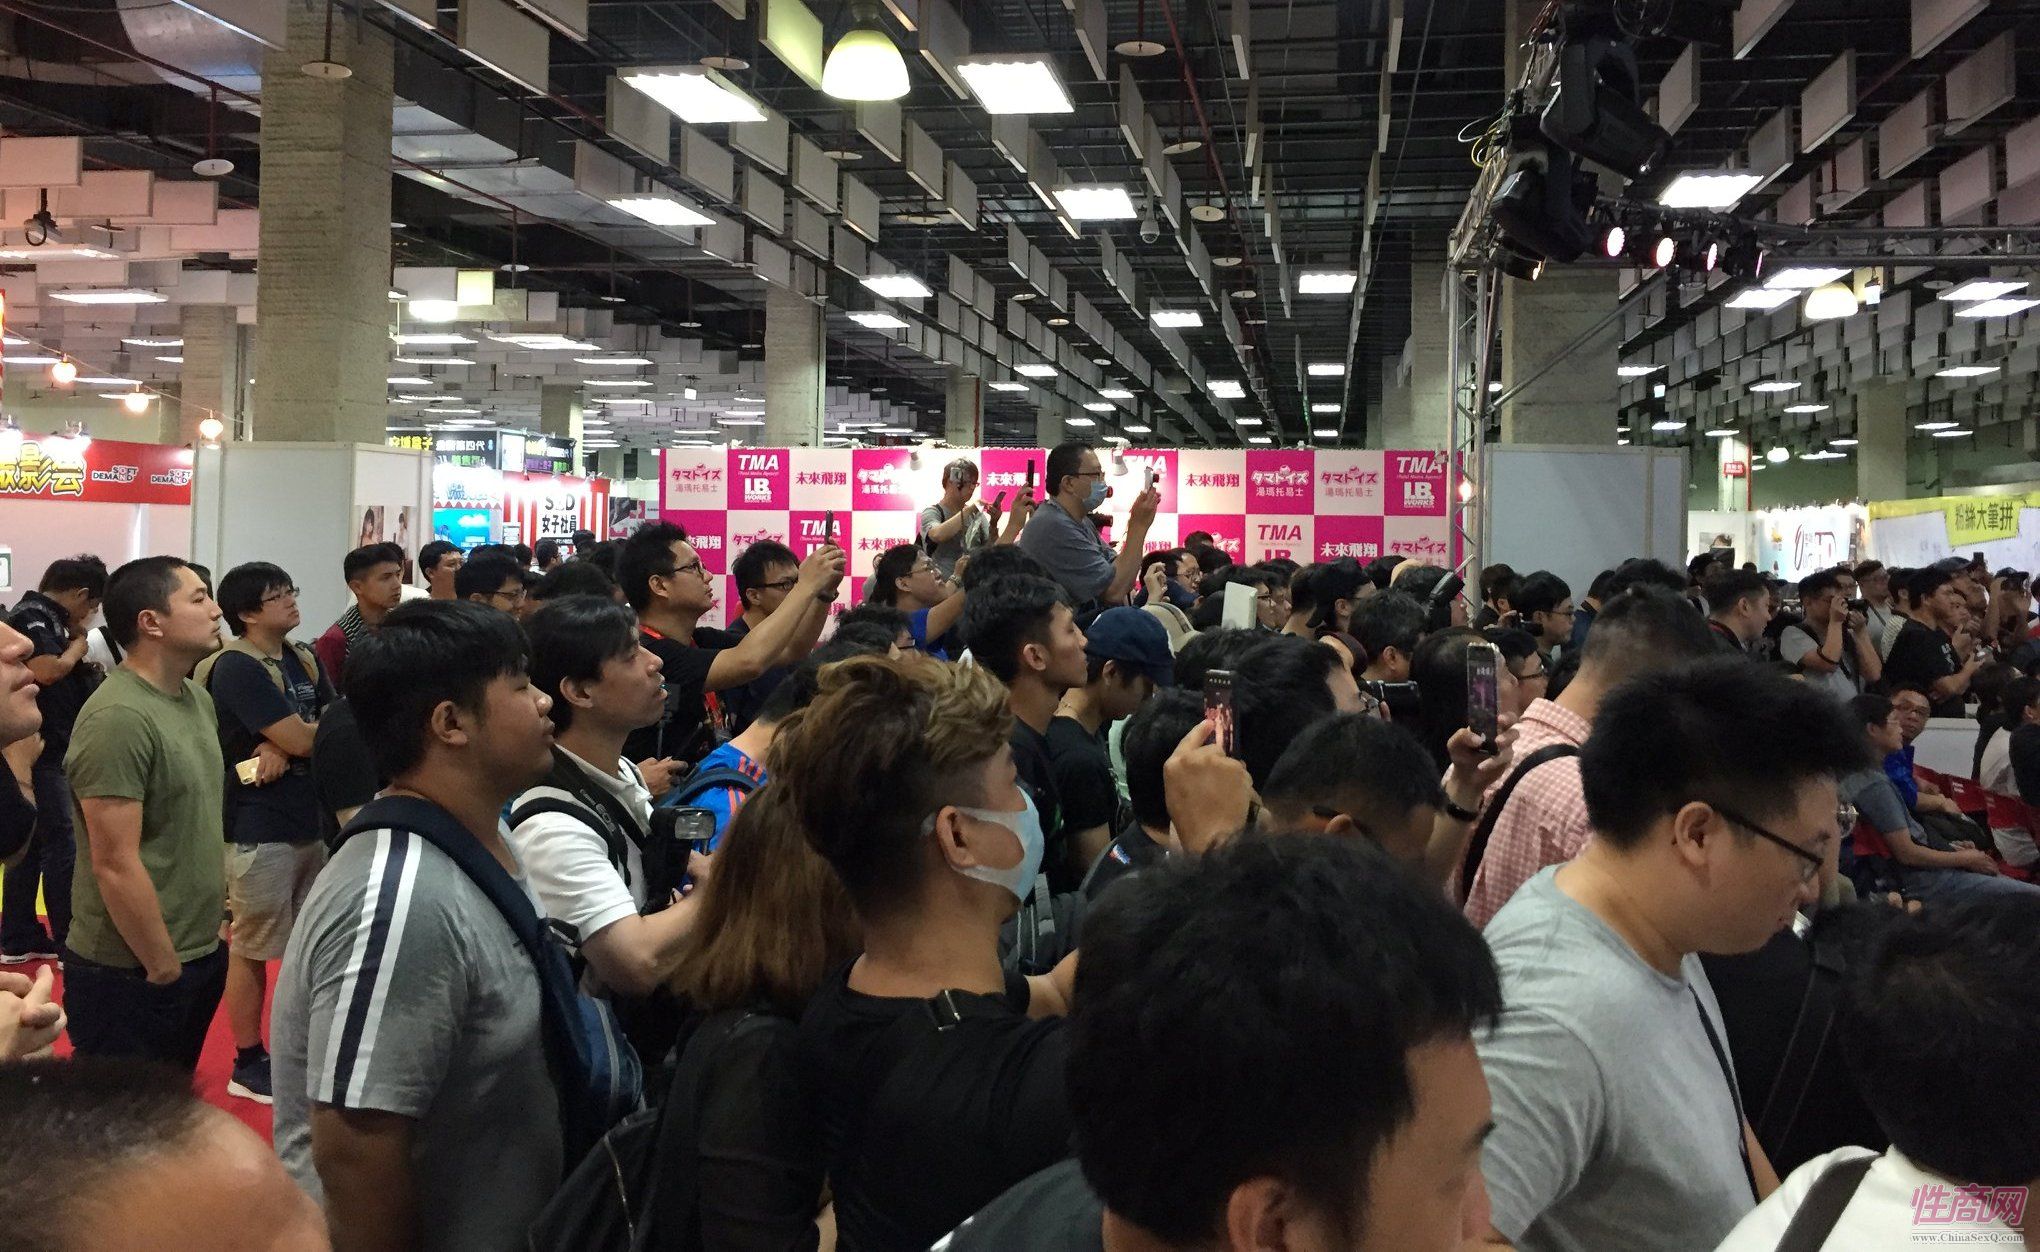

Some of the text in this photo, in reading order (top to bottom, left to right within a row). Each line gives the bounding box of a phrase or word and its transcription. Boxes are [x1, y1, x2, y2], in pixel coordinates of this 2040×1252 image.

[738, 454, 779, 471] TMA
[1397, 457, 1443, 474] TMA
[93, 472, 133, 481] DEMAND
[672, 470, 721, 480] タマトイズ
[796, 471, 847, 485] 未來飛翔
[1186, 473, 1239, 488] 未來飛翔
[1252, 472, 1309, 484] タマトイズ
[1321, 472, 1377, 484] タマトイズ
[545, 494, 576, 511] SD
[542, 514, 577, 534] 女子社員
[800, 520, 842, 536] TMA
[1258, 524, 1302, 541] TMA
[1320, 542, 1378, 558] 未來飛翔
[1391, 542, 1447, 554] タマトイズ
